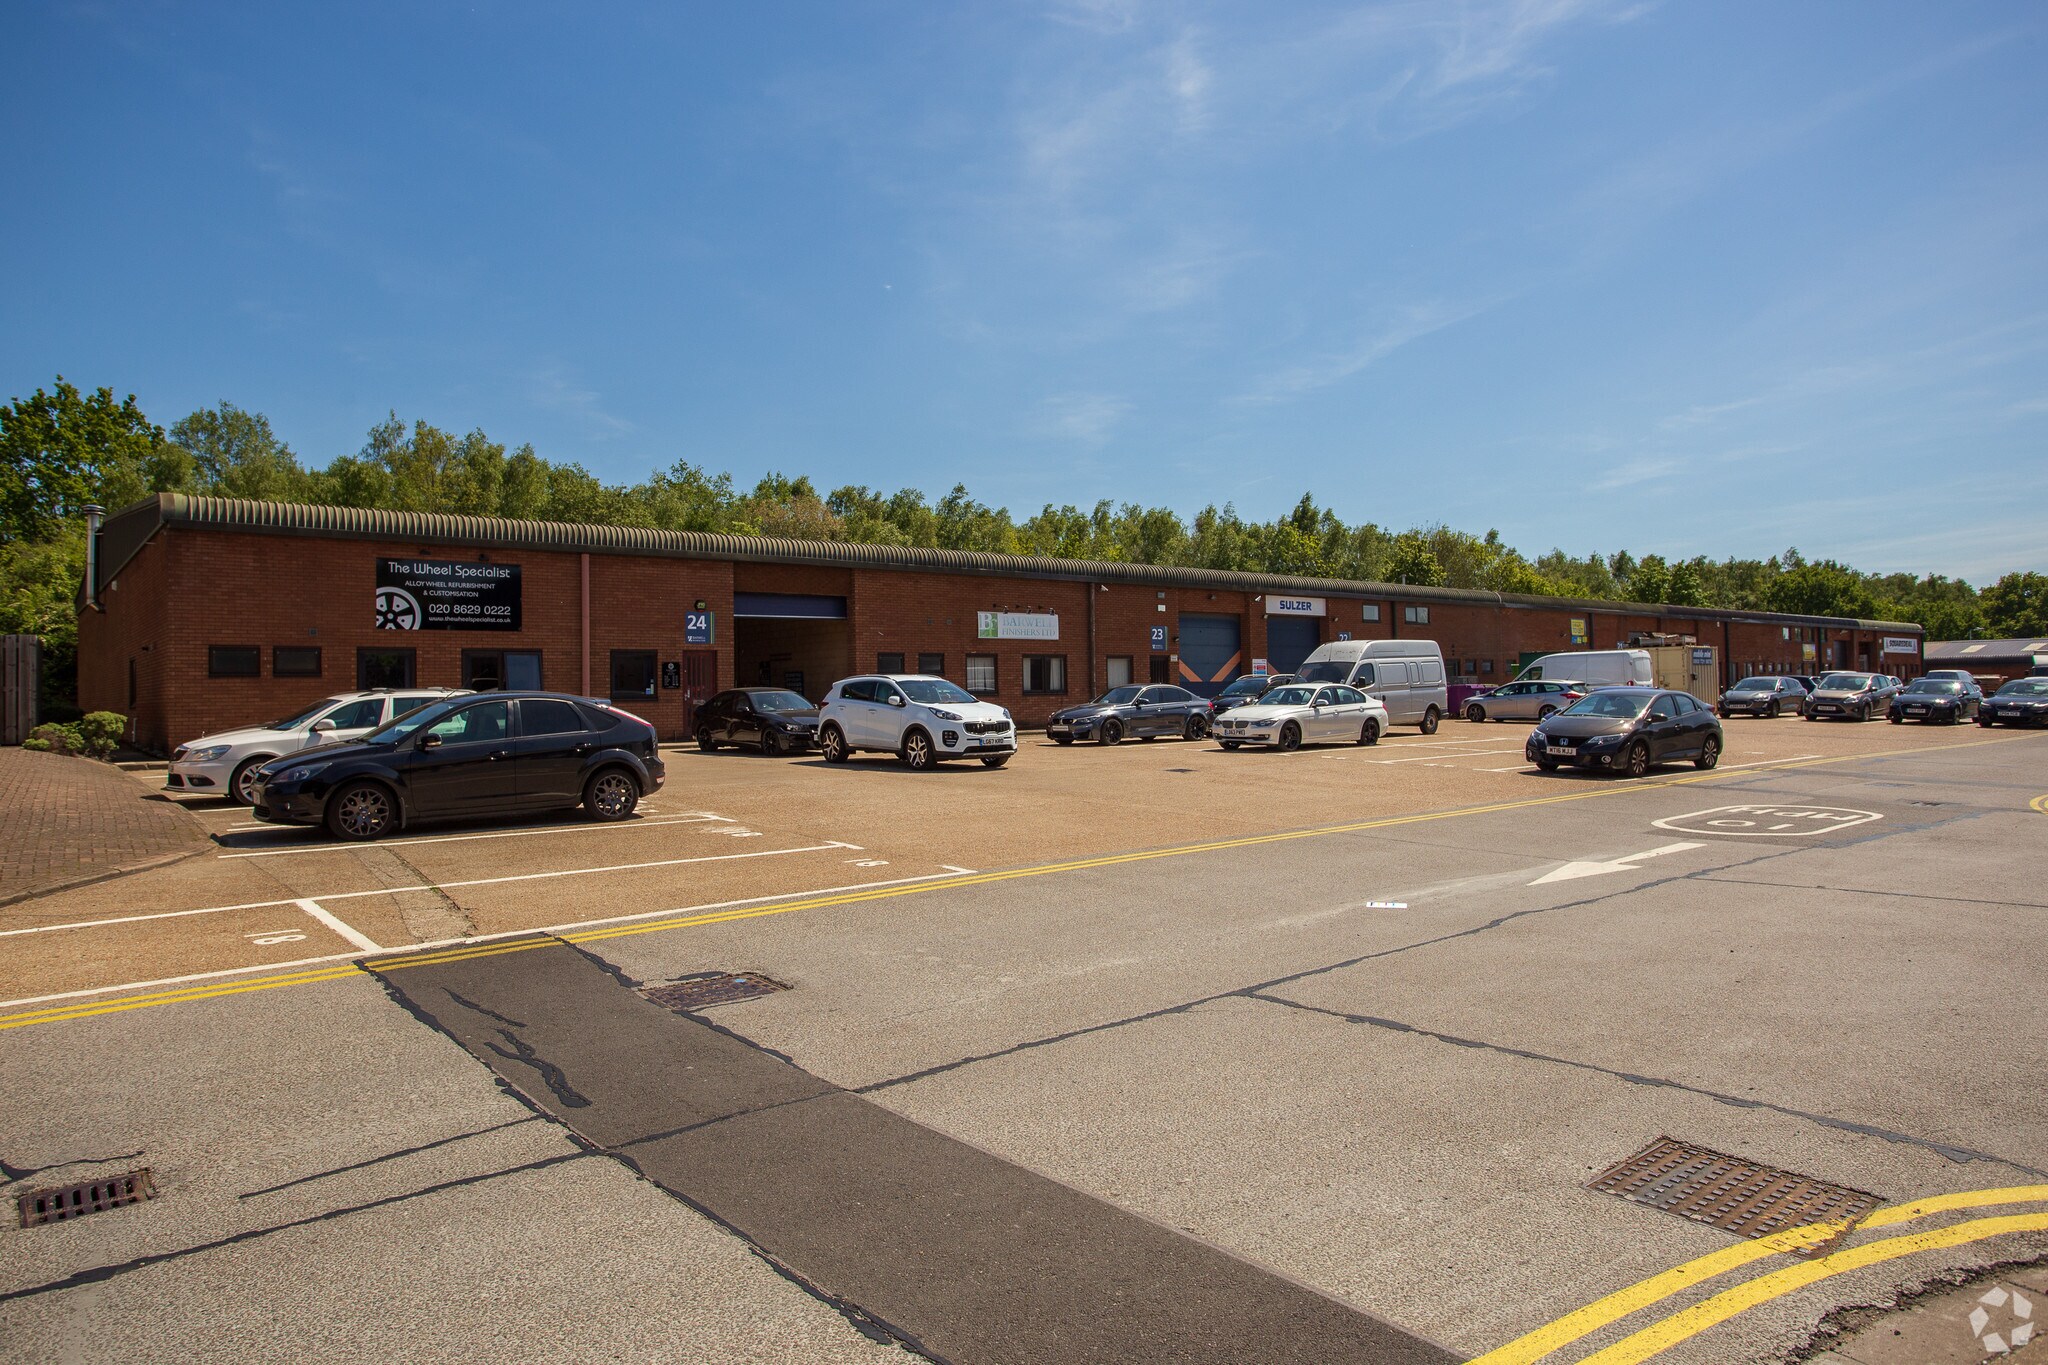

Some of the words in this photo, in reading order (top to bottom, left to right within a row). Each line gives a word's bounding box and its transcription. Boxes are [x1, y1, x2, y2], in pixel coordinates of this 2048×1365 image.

[388, 562, 410, 573] The
[413, 563, 452, 575] Wheel
[455, 565, 510, 578] Specialist
[429, 604, 450, 614] 020
[453, 605, 481, 615] 8629
[484, 605, 511, 615] 0222
[1280, 600, 1312, 611] SULZER
[687, 615, 707, 630] 24
[1002, 628, 1040, 636] FINISHERS
[1041, 629, 1056, 637] LTD
[1152, 628, 1163, 640] 23
[1725, 806, 1863, 820] MPH
